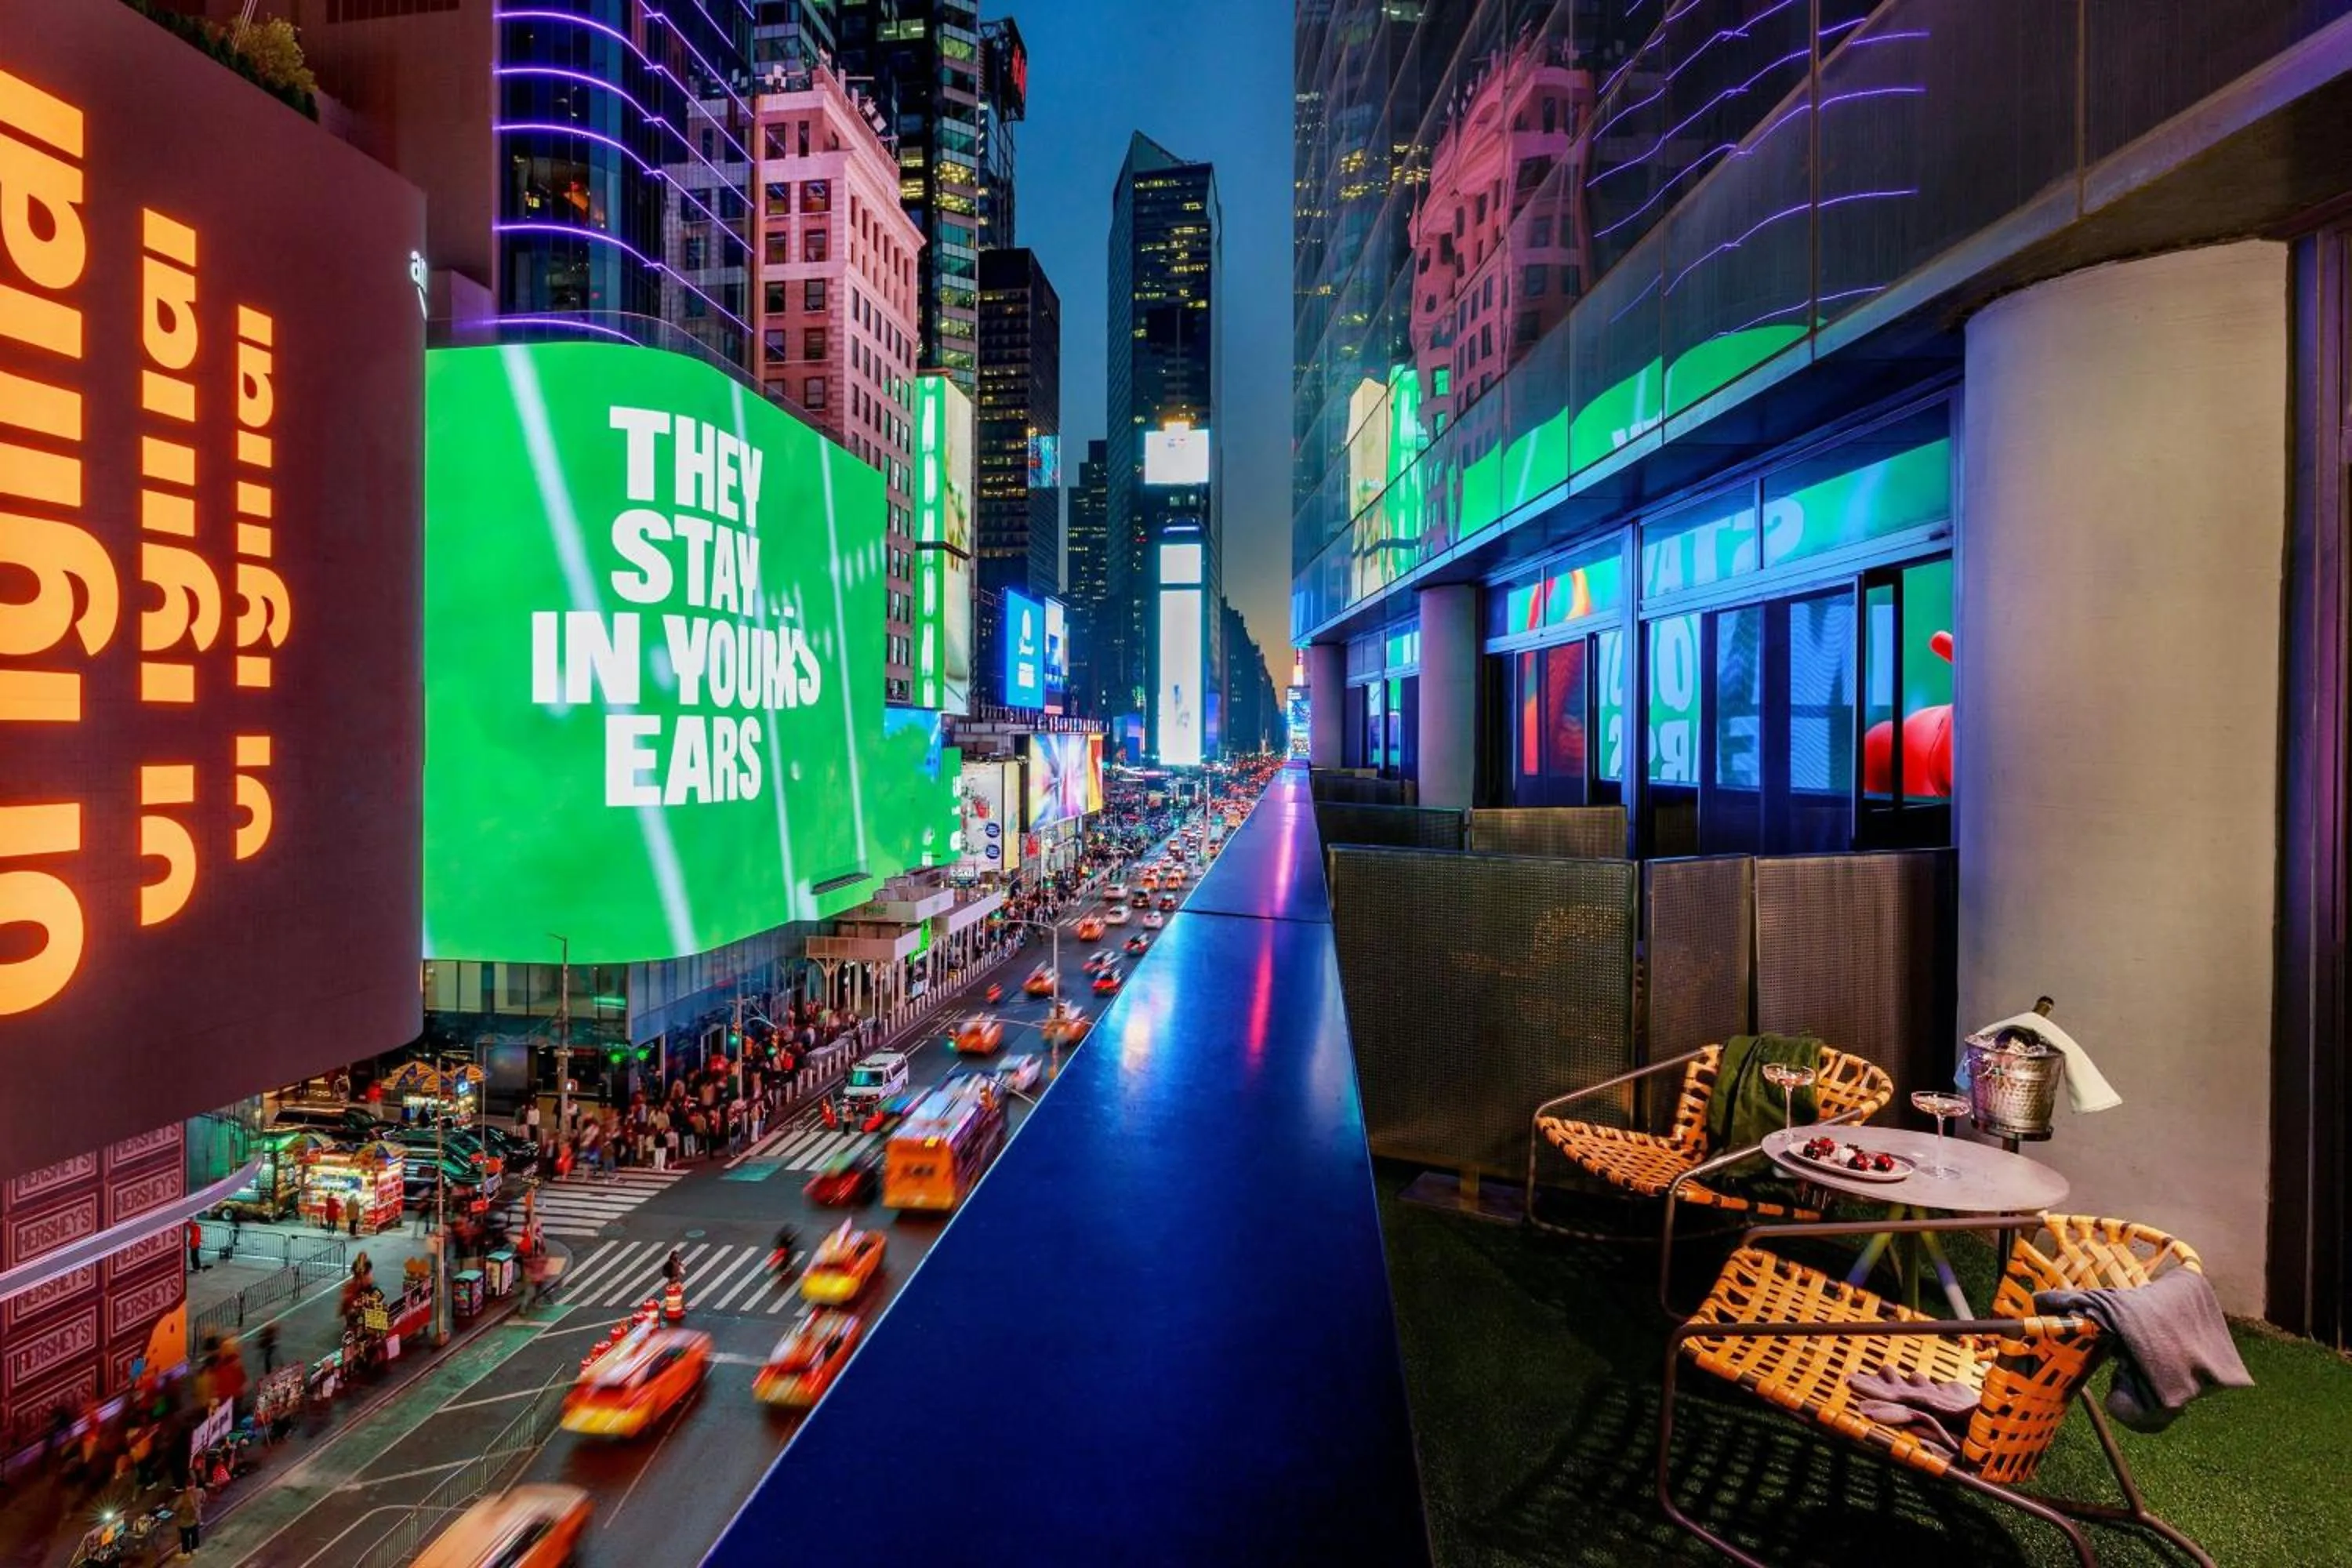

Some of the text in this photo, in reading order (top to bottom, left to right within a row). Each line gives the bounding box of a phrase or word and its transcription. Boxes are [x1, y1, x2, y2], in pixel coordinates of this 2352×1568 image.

[609, 406, 762, 528] THEY
[612, 509, 760, 617] STAY
[532, 611, 640, 705] IN
[606, 714, 761, 807] EARS
